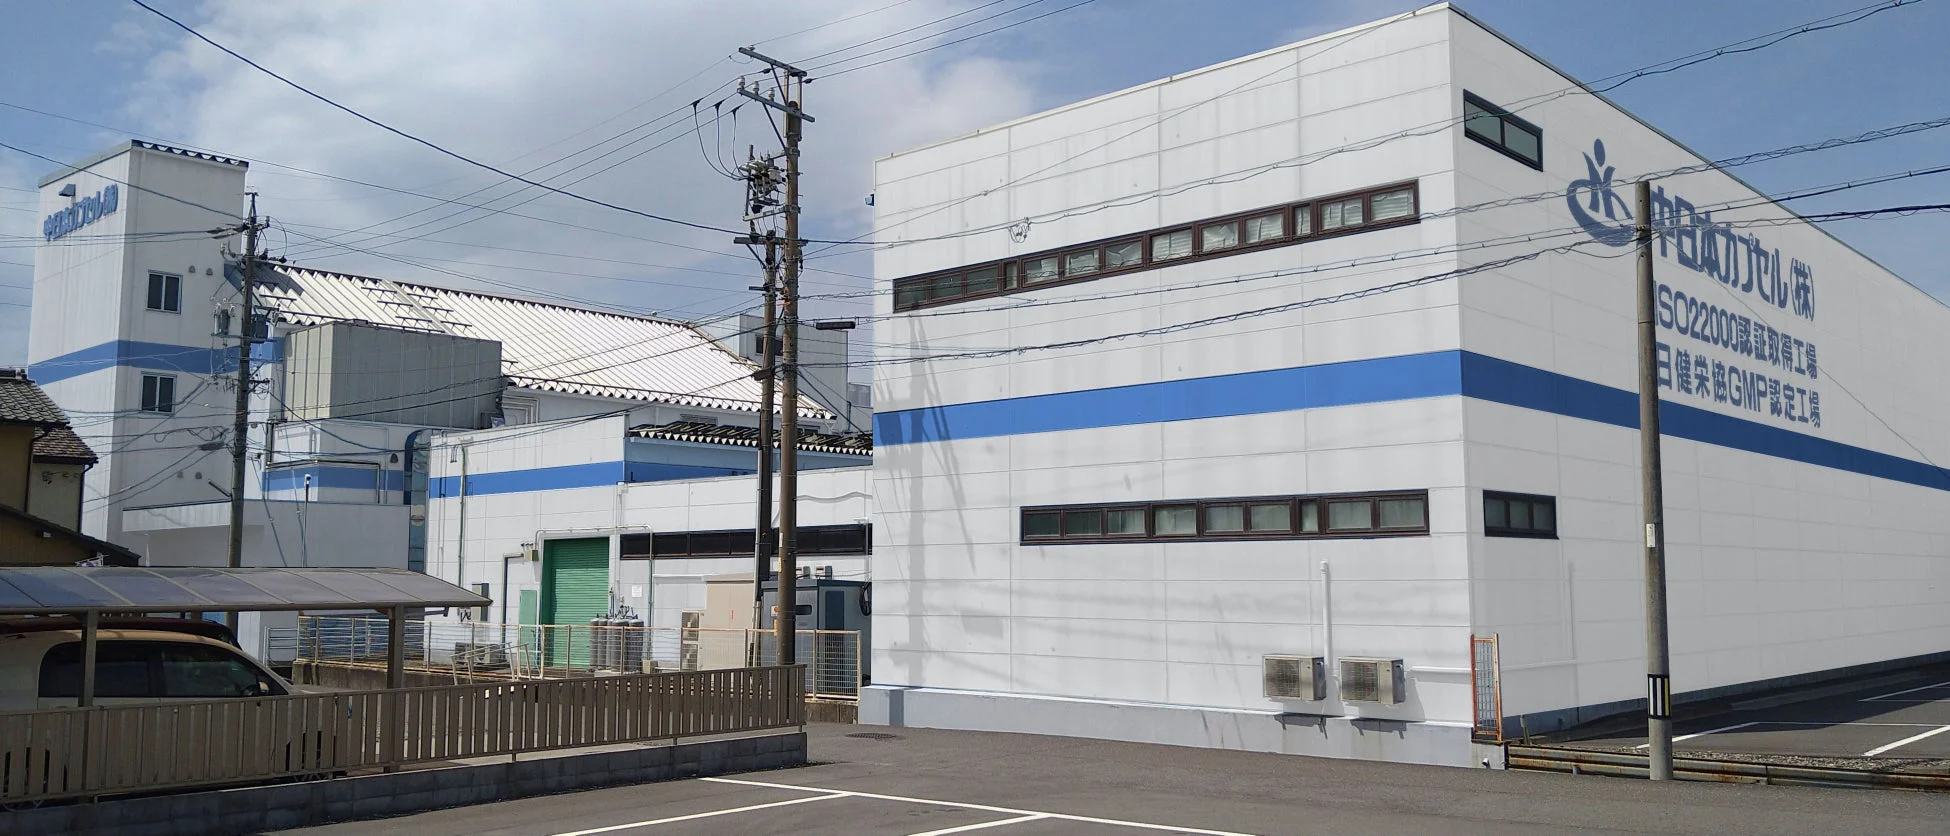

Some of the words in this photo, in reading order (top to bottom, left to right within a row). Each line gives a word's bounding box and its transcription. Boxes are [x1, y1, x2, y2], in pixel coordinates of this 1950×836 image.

[1650, 185, 1815, 322] 中日本カプセル(株)
[1653, 280, 1817, 380] ISO22000認証取得工場
[1656, 341, 1821, 428] 日健栄協GMP認定工場
